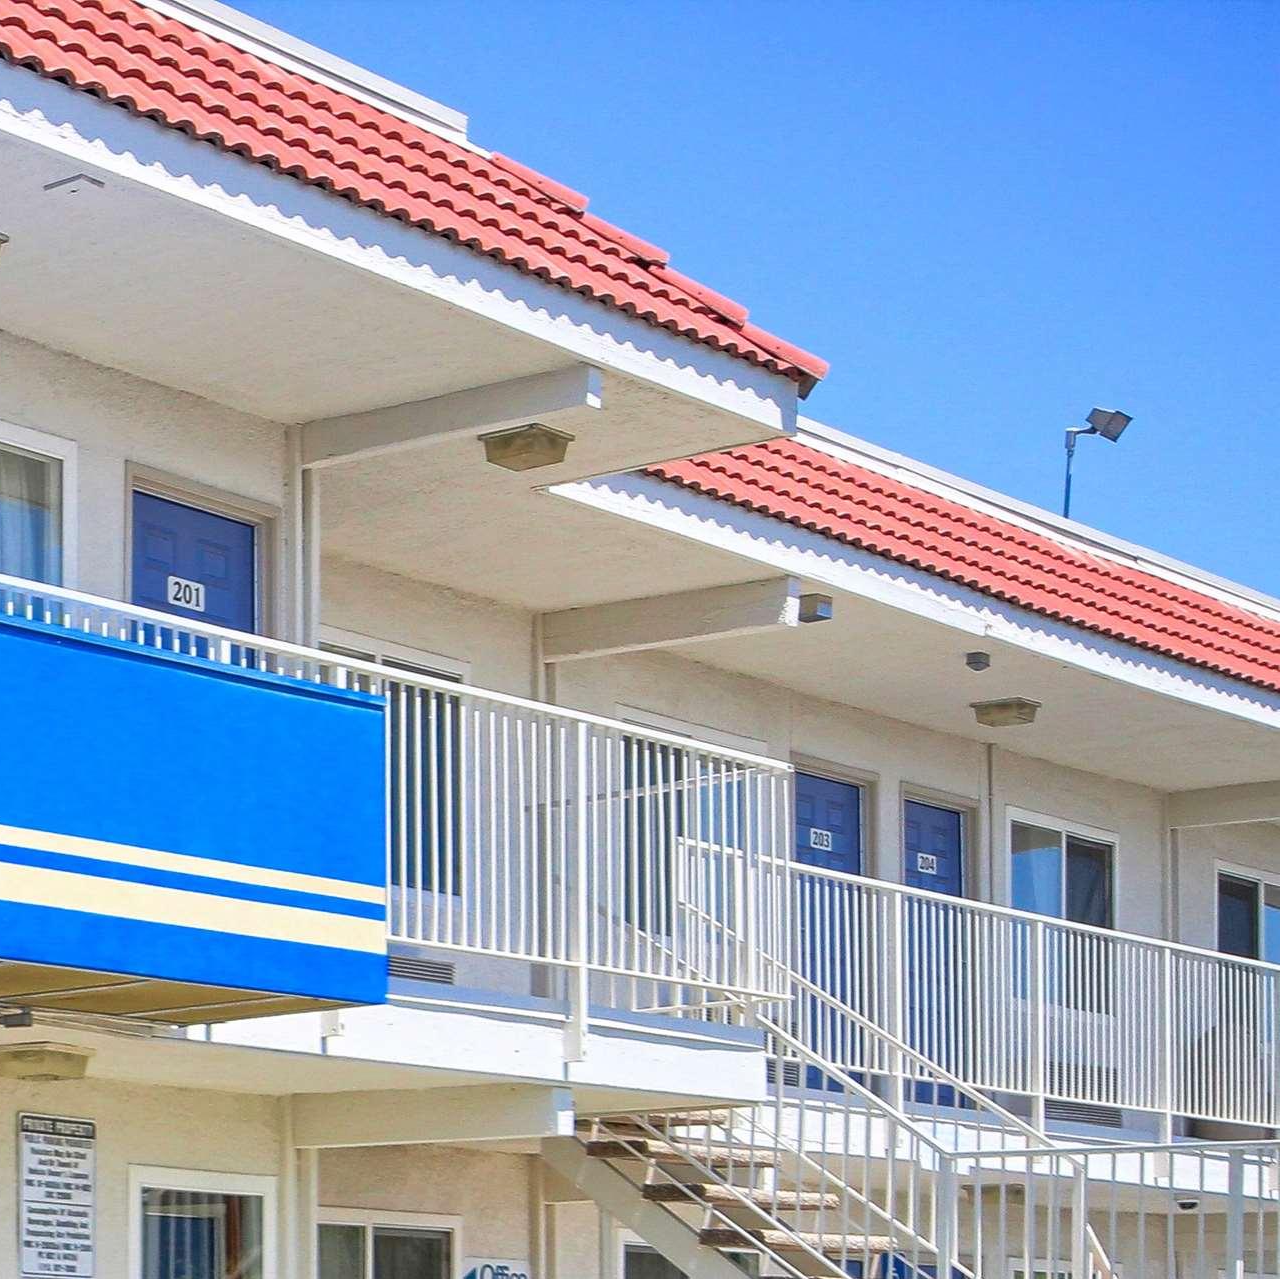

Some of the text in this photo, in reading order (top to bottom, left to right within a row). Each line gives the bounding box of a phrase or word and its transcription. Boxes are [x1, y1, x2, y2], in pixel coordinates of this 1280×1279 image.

[173, 581, 201, 607] 201
[812, 831, 830, 848] 203
[919, 855, 935, 871] 204
